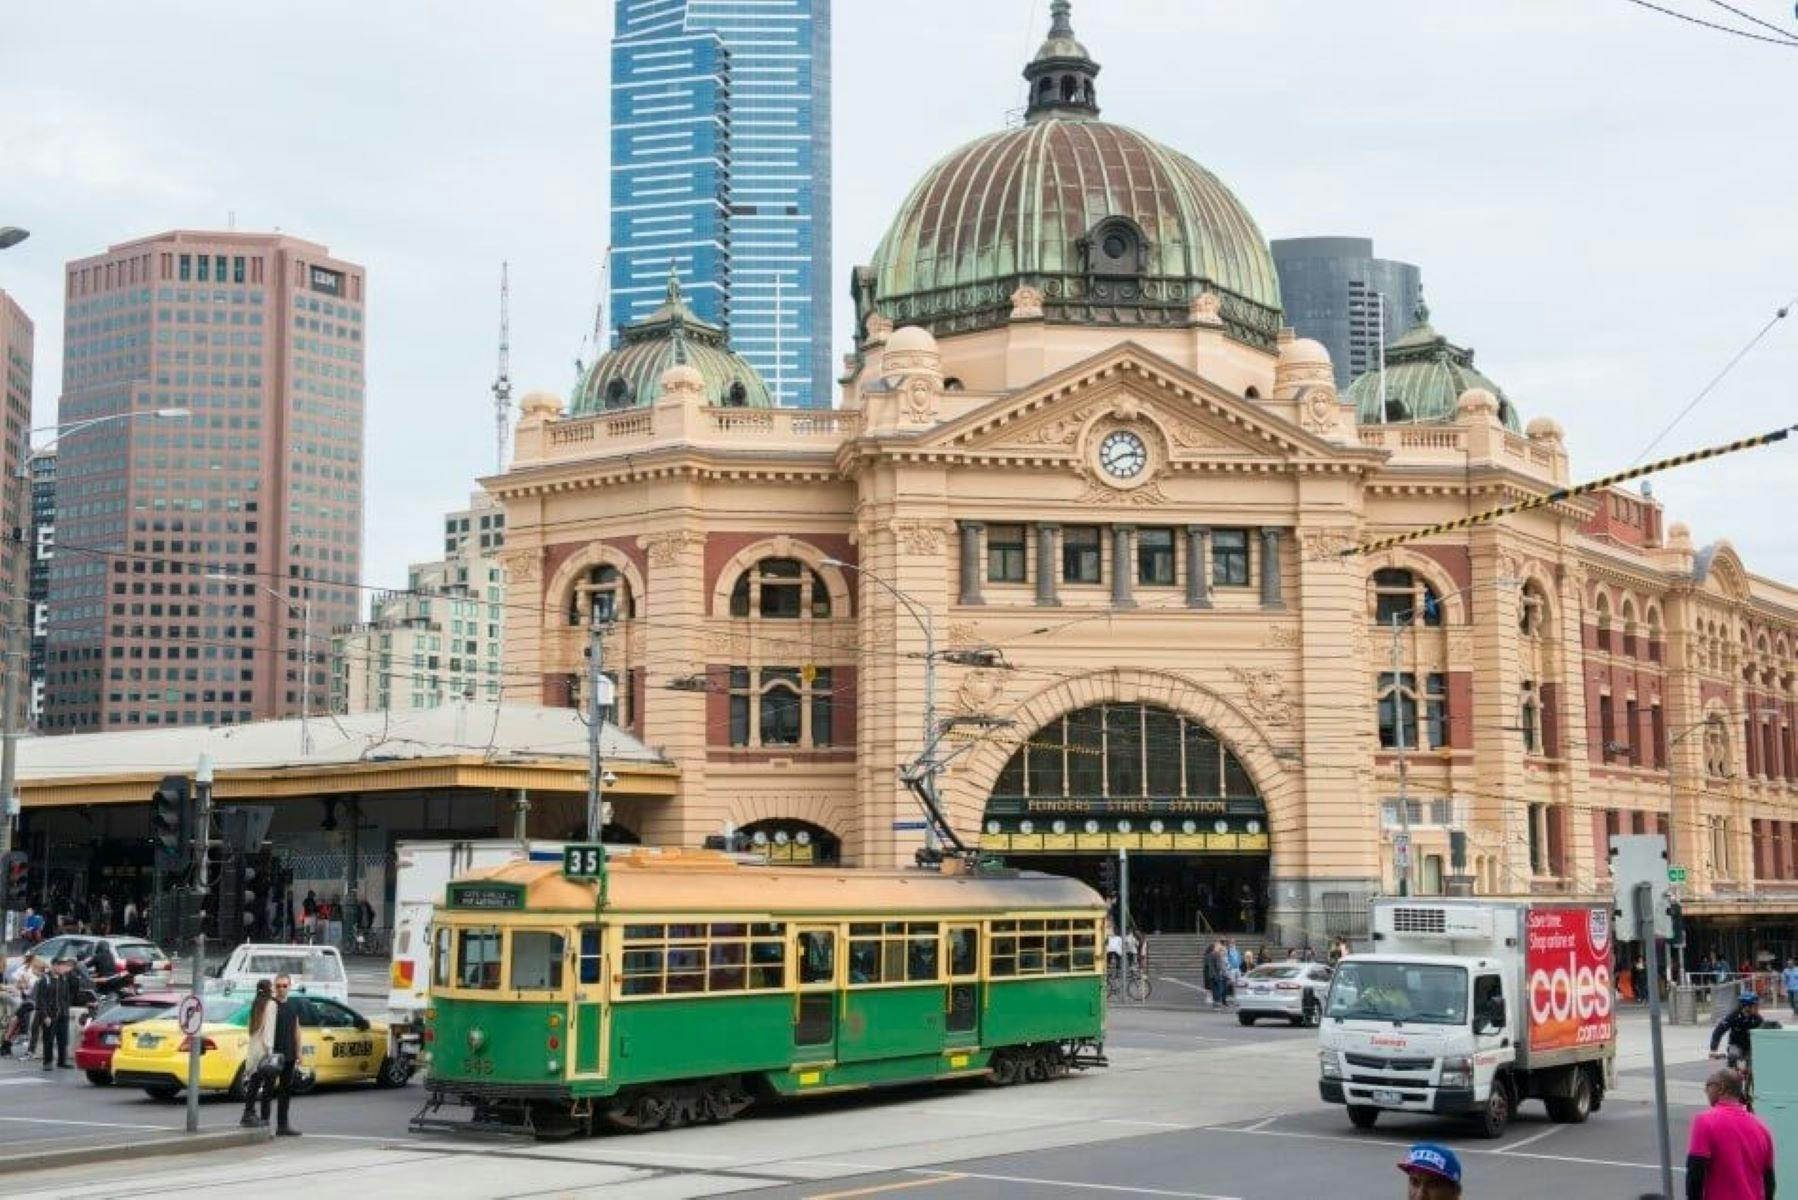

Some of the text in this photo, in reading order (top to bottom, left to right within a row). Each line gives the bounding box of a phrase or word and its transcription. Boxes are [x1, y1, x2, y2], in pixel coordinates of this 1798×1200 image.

[1028, 800, 1227, 813] FLINDERS STREET STATION
[570, 850, 597, 872] 35
[1529, 910, 1546, 928] Save
[1529, 932, 1546, 953] Shop
[1547, 932, 1568, 948] online
[1530, 951, 1610, 1025] coles
[1576, 1022, 1611, 1042] .com.au
